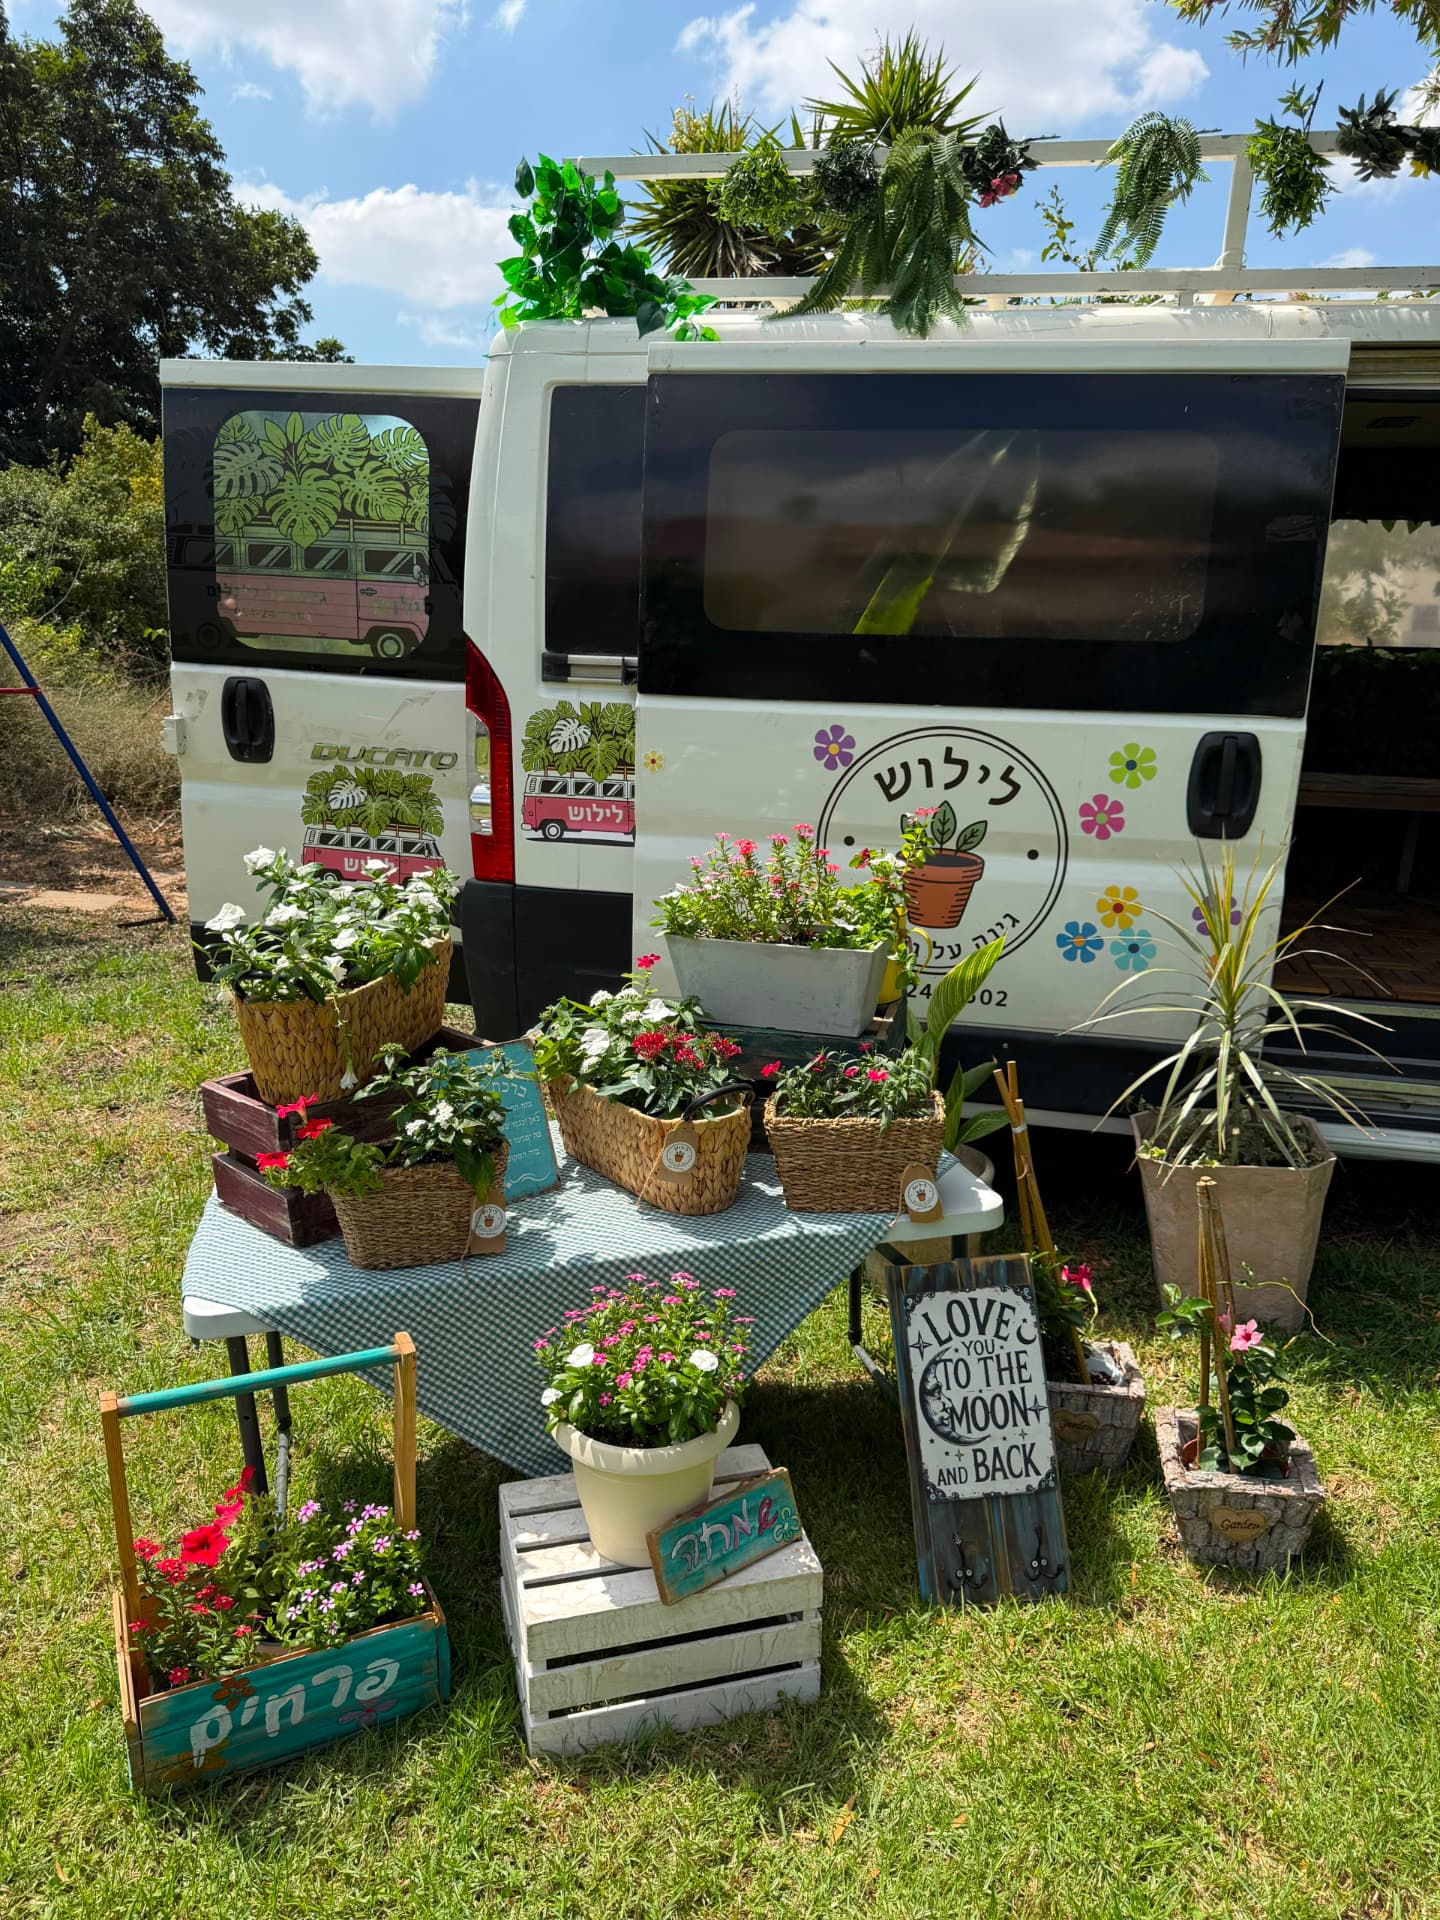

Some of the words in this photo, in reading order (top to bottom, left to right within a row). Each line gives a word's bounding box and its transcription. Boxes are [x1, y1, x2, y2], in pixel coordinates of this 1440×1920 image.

[310, 743, 458, 770] DUCATO
[873, 746, 1022, 806] לילוש
[567, 803, 624, 824] לילוש
[932, 940, 962, 960] על
[492, 1081, 527, 1098] ברכת
[921, 1296, 1016, 1347] LOVE
[960, 1339, 995, 1356] YOU
[936, 1357, 971, 1391] TO
[977, 1350, 1032, 1388] THE
[950, 1386, 1031, 1434] MOON
[937, 1466, 968, 1487] AND
[972, 1442, 1042, 1483] BACK
[671, 1497, 779, 1572] שמחה
[1221, 1518, 1260, 1530] Garden
[190, 1657, 400, 1769] פרחים
